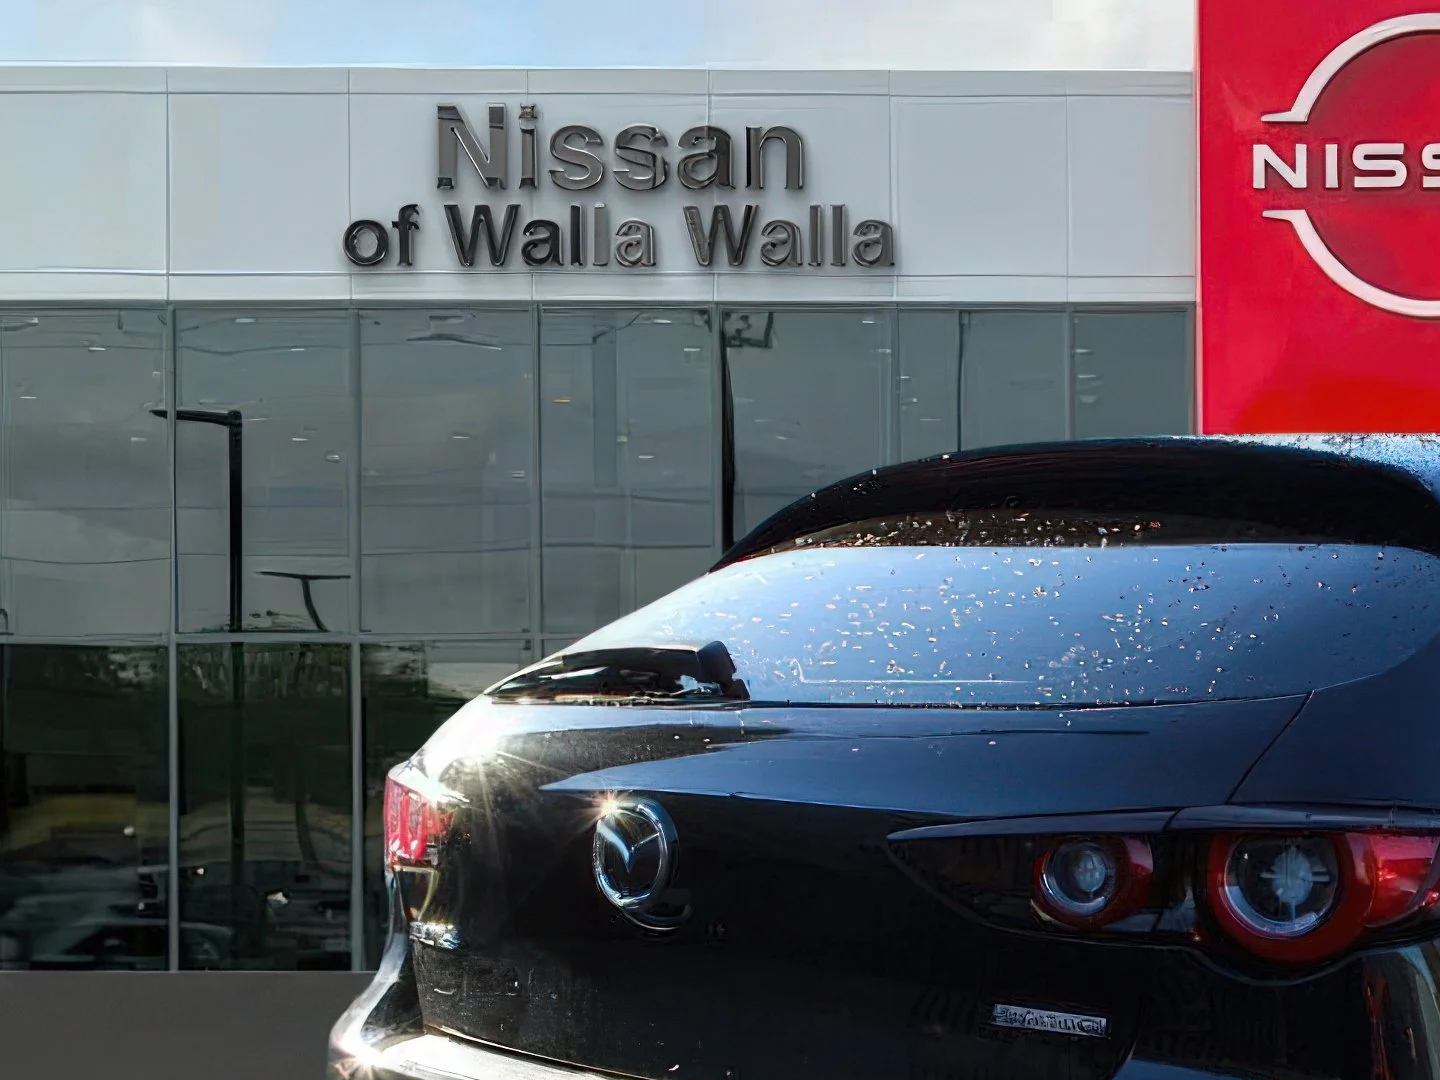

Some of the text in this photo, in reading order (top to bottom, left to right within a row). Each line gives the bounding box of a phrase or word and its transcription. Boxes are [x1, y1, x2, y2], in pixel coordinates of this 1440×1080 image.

[436, 102, 804, 191] Nissan
[342, 203, 896, 267] of Walla Walla
